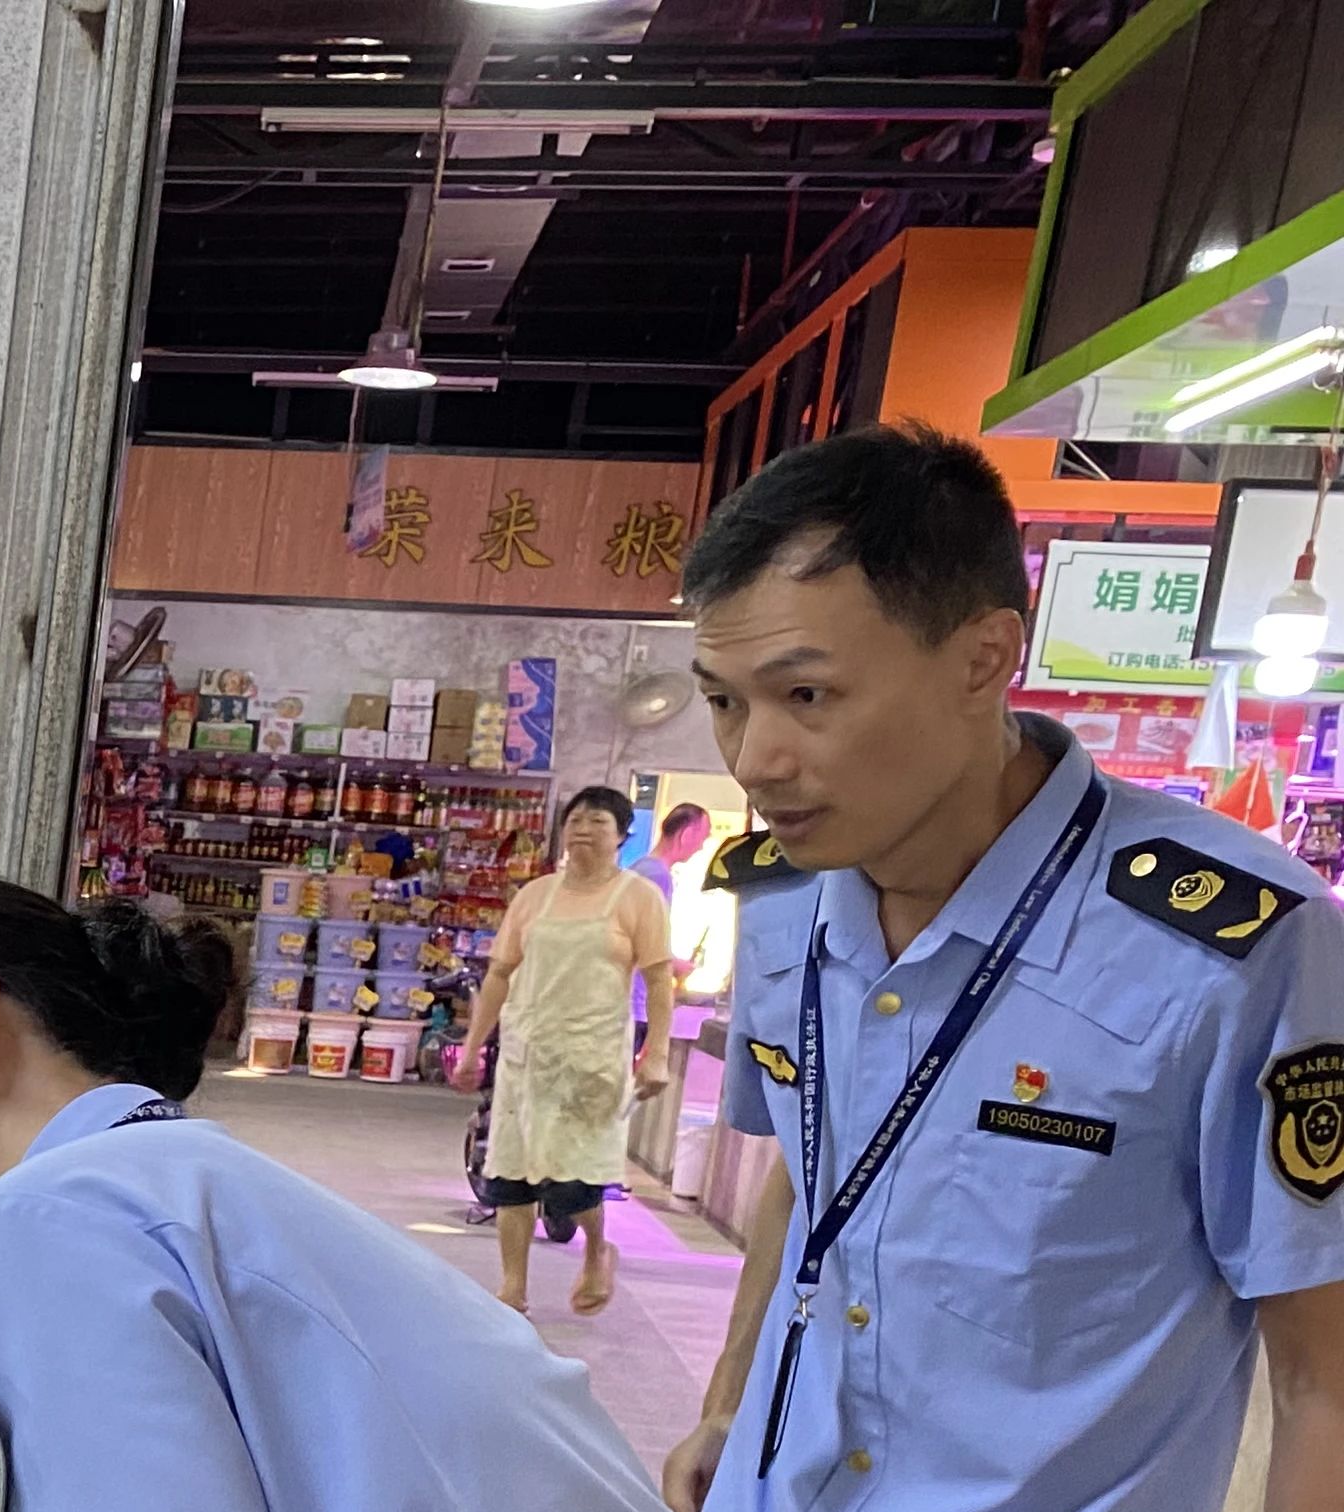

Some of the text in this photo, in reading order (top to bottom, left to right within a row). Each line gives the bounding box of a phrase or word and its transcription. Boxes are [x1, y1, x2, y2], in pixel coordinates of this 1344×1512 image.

[1092, 567, 1201, 615] 娟娟
[1274, 1055, 1344, 1087] 中华人民共
[988, 1106, 1106, 1145] 19050230107
